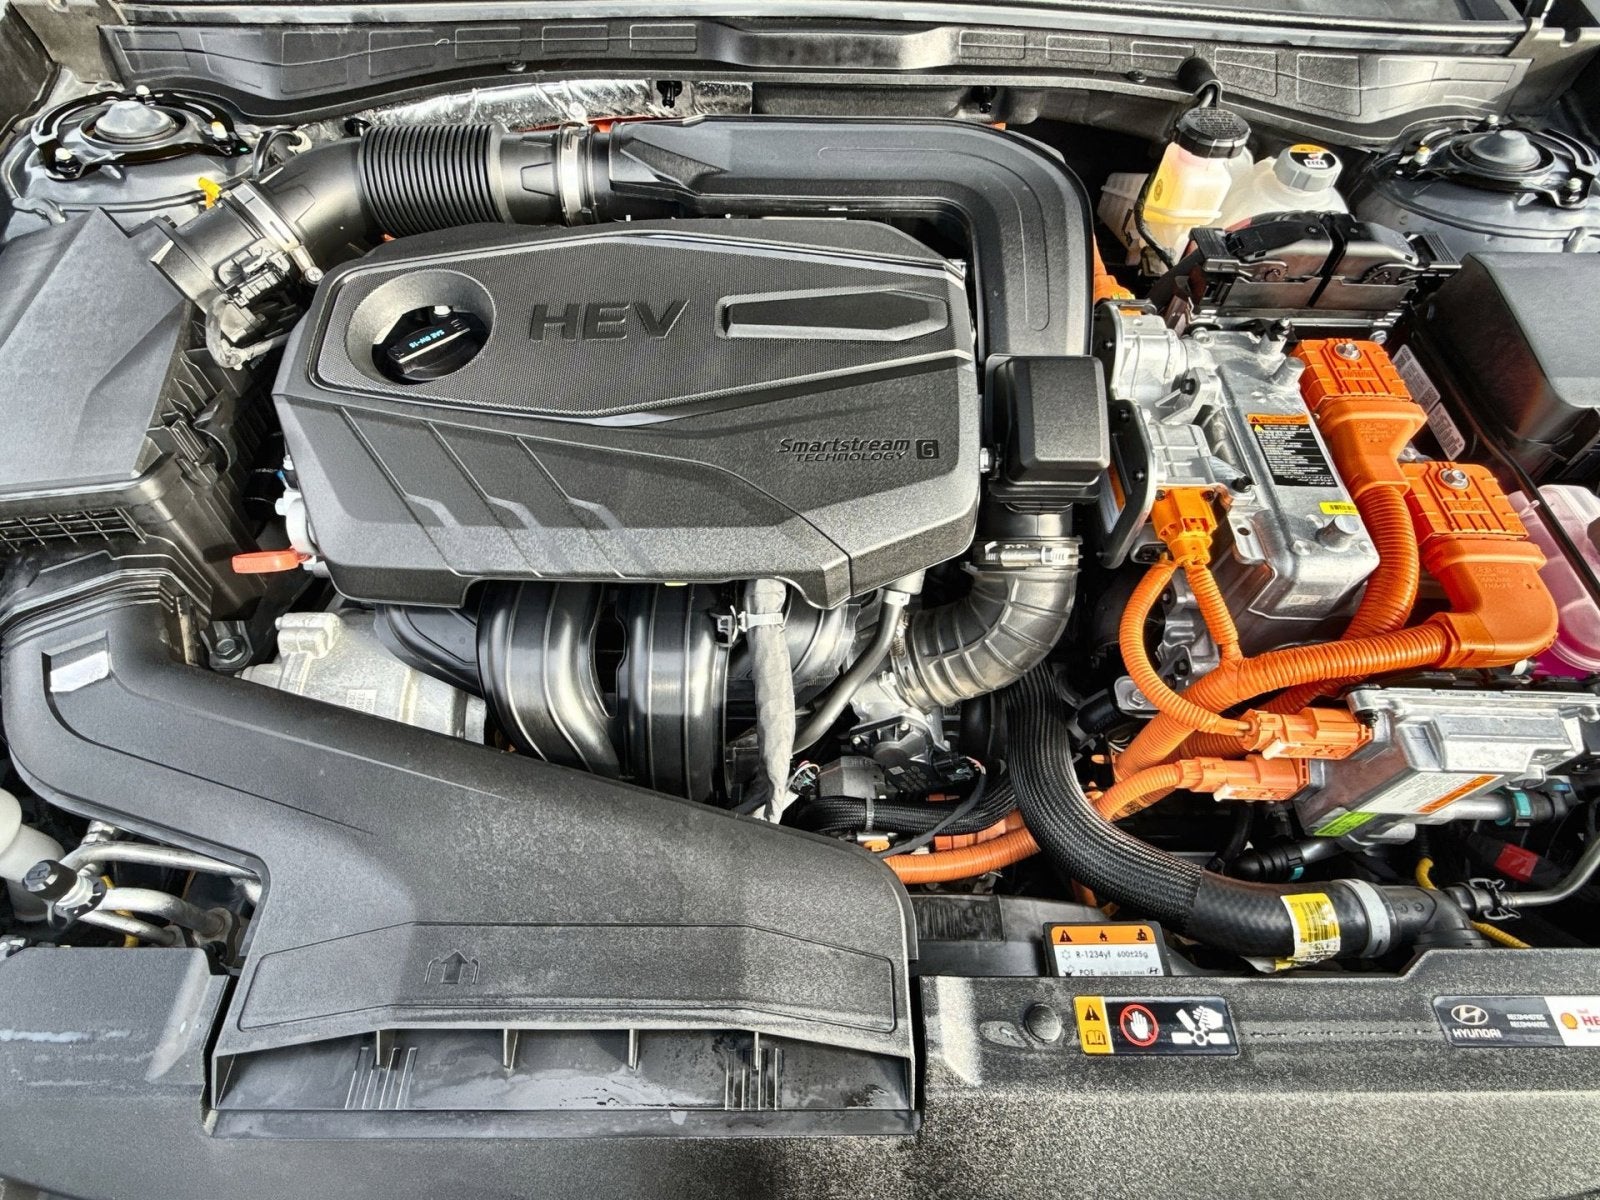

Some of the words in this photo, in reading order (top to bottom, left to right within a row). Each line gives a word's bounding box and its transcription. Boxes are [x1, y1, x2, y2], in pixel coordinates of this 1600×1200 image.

[529, 300, 690, 342] HEV
[777, 437, 911, 453] Smartstream
[917, 440, 938, 459] G
[793, 450, 906, 462] TECHNOLOGY
[1075, 949, 1112, 960] R-1234yf
[1452, 1028, 1503, 1039] HYUNDAI
